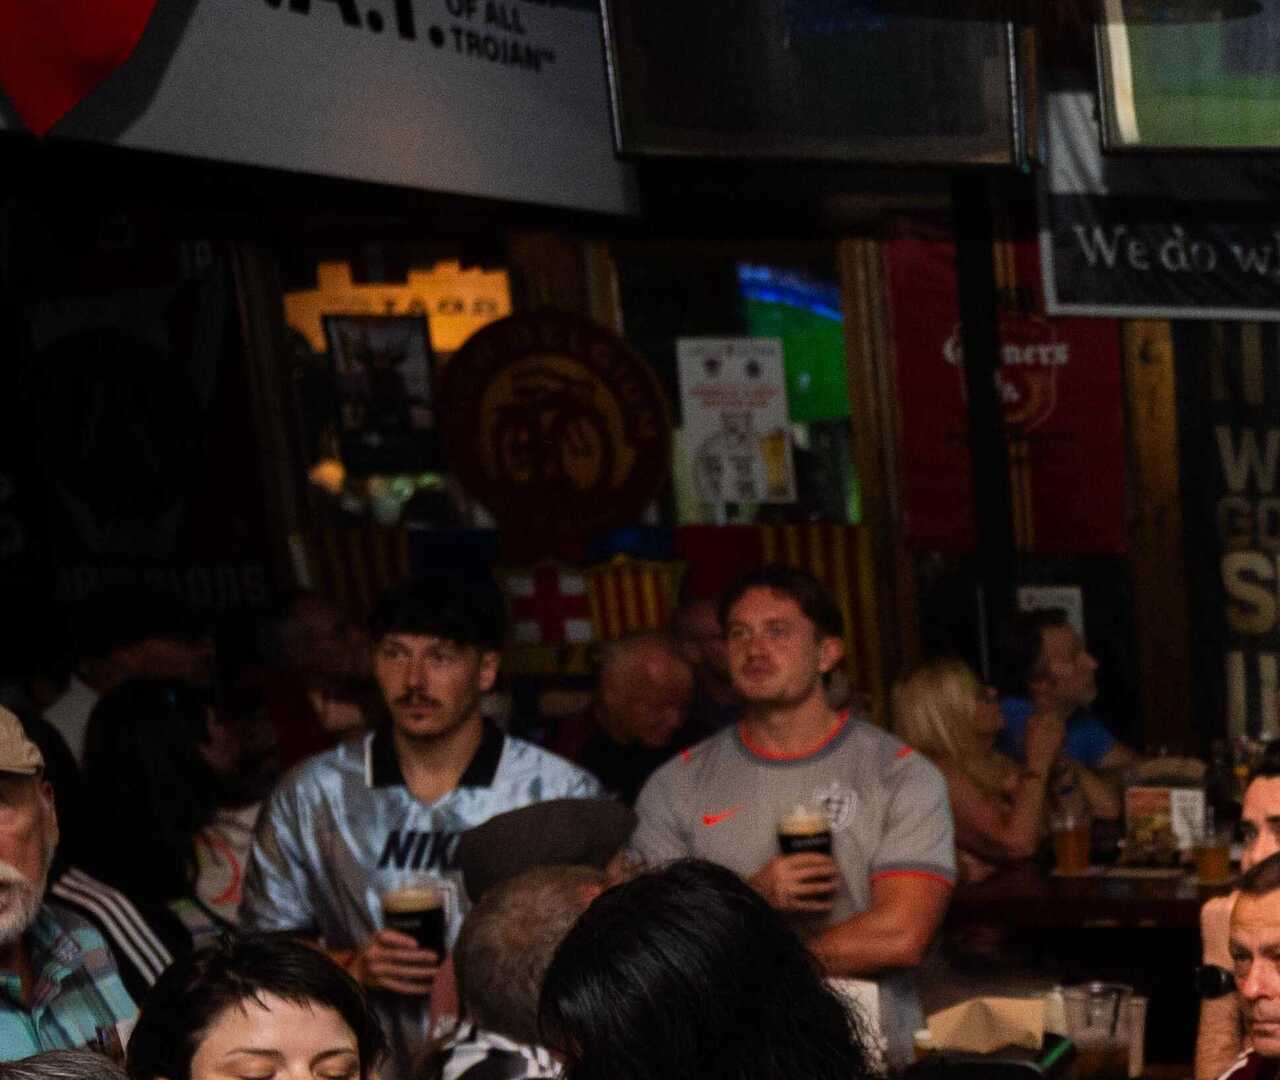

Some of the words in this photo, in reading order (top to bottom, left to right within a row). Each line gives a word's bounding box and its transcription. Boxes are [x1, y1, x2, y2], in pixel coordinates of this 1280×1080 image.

[1073, 223, 1150, 271] We
[1160, 226, 1217, 272] do
[378, 831, 461, 869] NIK
